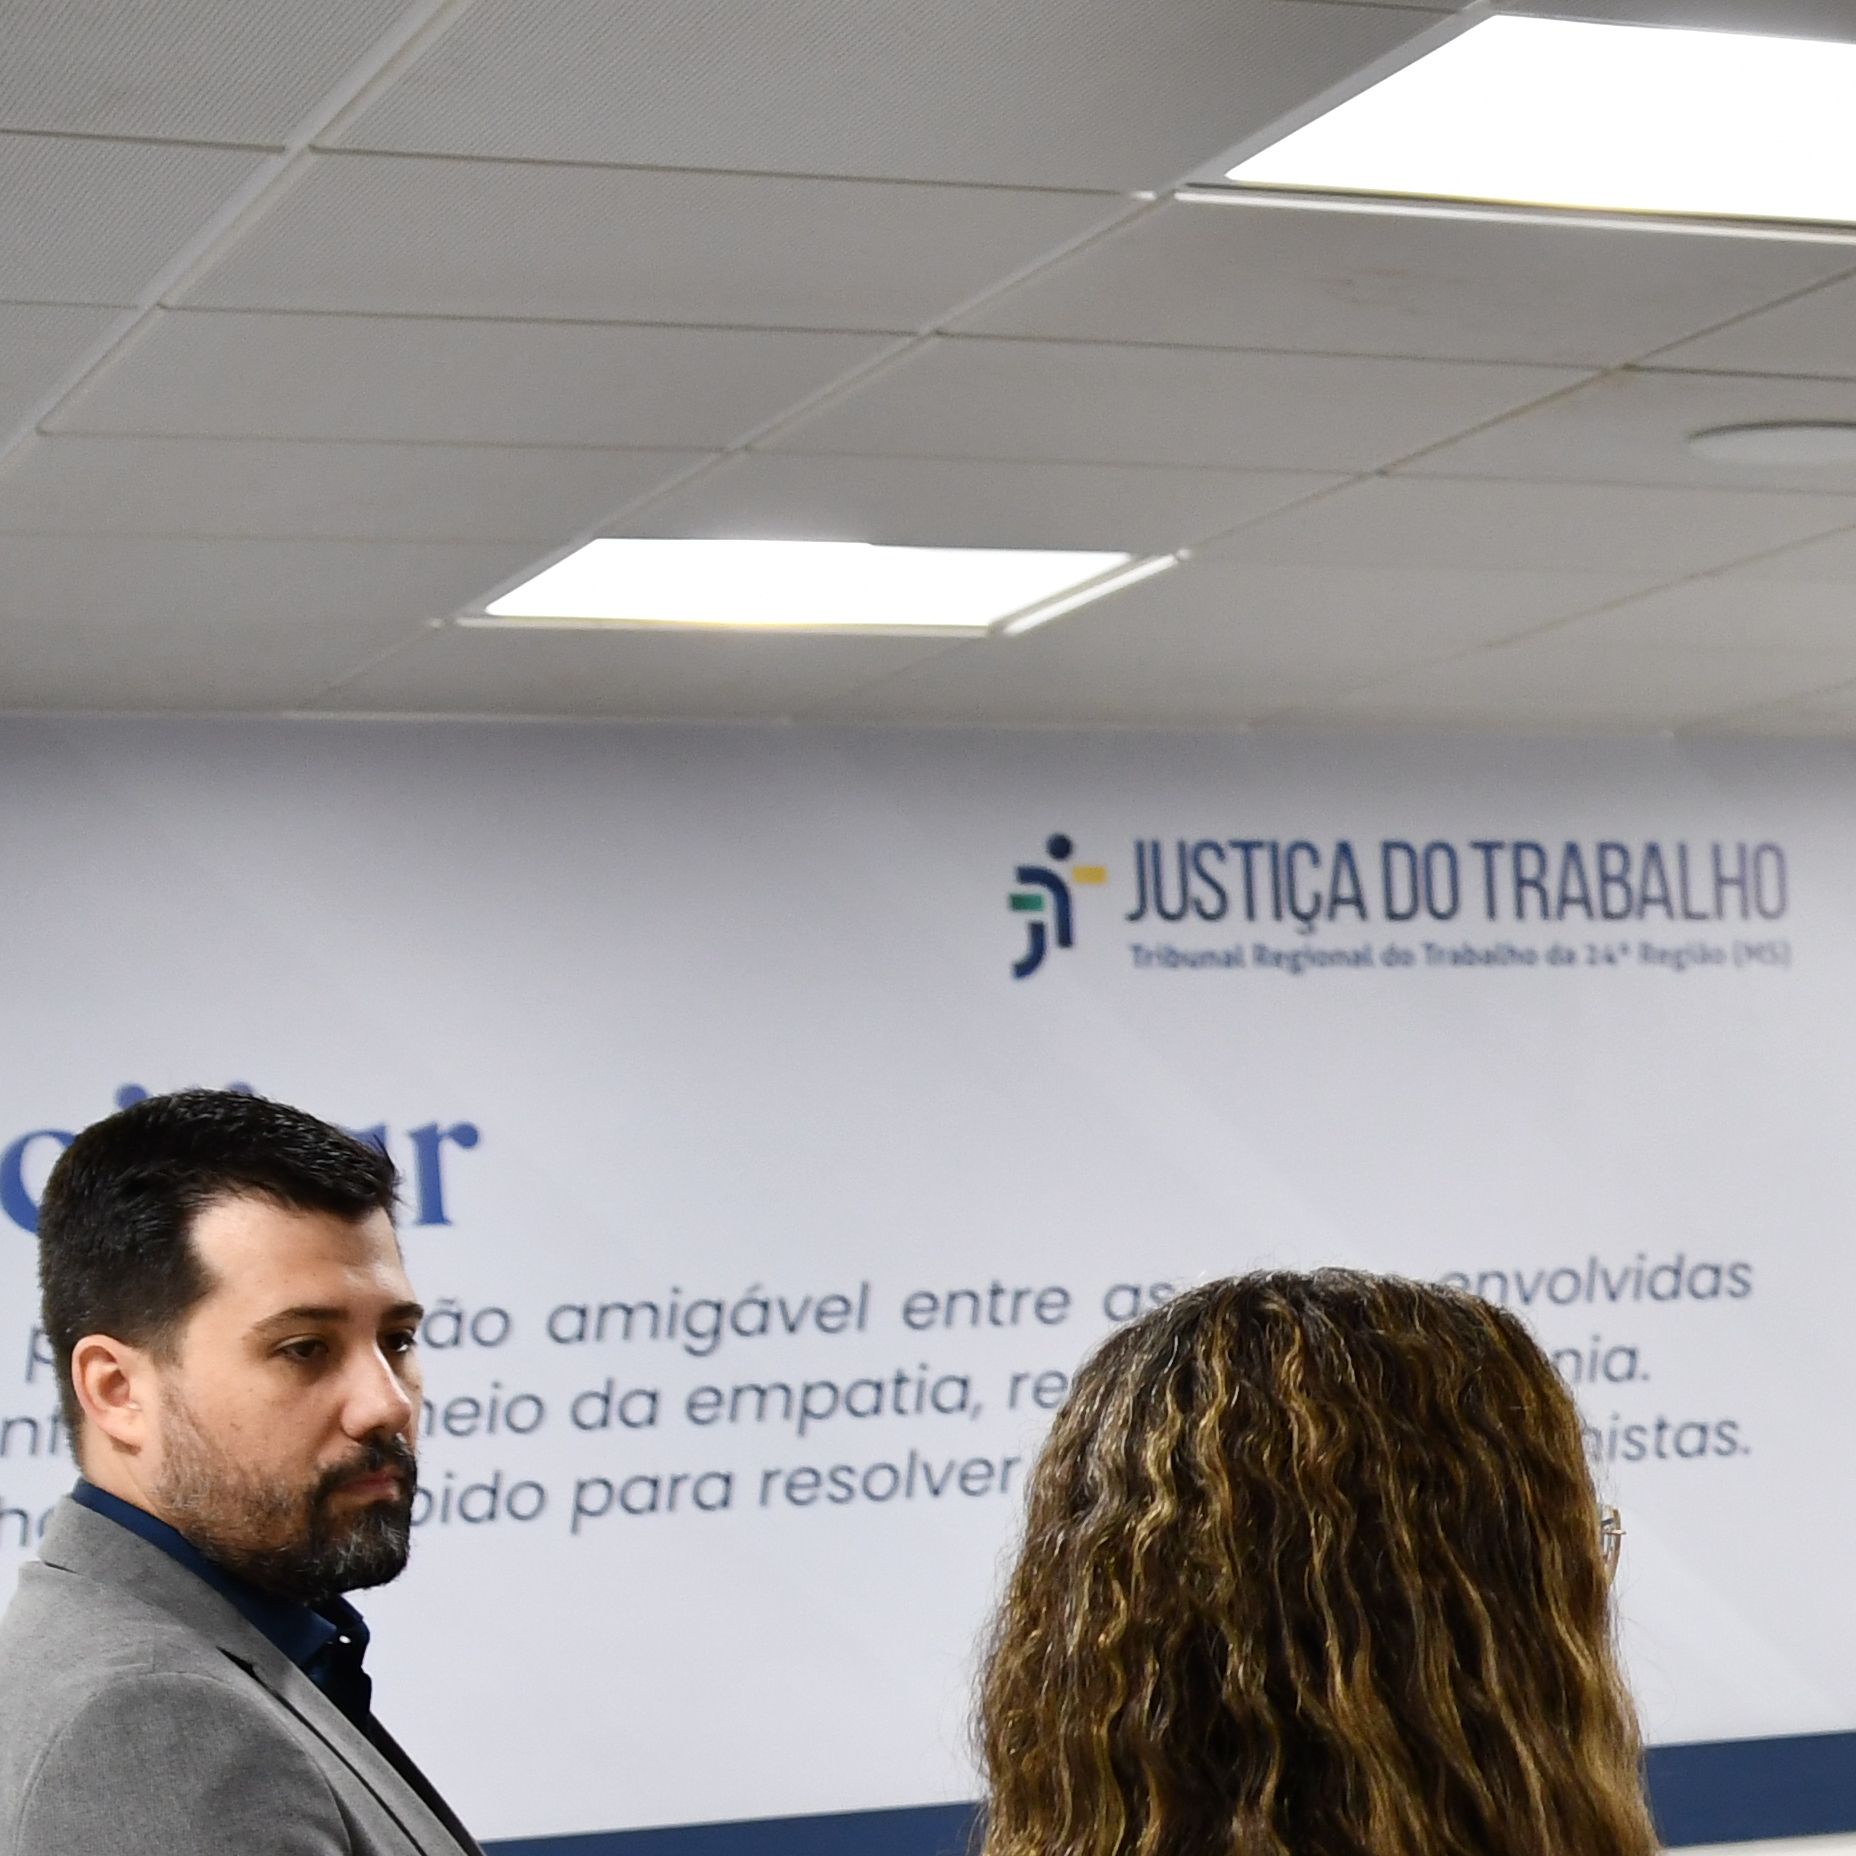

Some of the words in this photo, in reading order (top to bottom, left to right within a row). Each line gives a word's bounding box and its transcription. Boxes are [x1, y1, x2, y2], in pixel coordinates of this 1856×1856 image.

[1125, 839, 1368, 935] JUSTIÇA
[1381, 840, 1461, 922] DO
[1471, 839, 1790, 922] TRABALHO
[1132, 943, 1244, 968] Tribunal
[1252, 943, 1374, 975] Regional
[1379, 943, 1416, 967] do
[1422, 941, 1538, 966] Trabalho
[1545, 941, 1577, 966] da
[1638, 941, 1727, 971] Região
[546, 1282, 871, 1357] amigável
[902, 1280, 1071, 1330] entre
[570, 1378, 659, 1432] da
[685, 1362, 984, 1437] empatia,
[570, 1468, 733, 1535] para
[758, 1449, 1022, 1509] resolver
